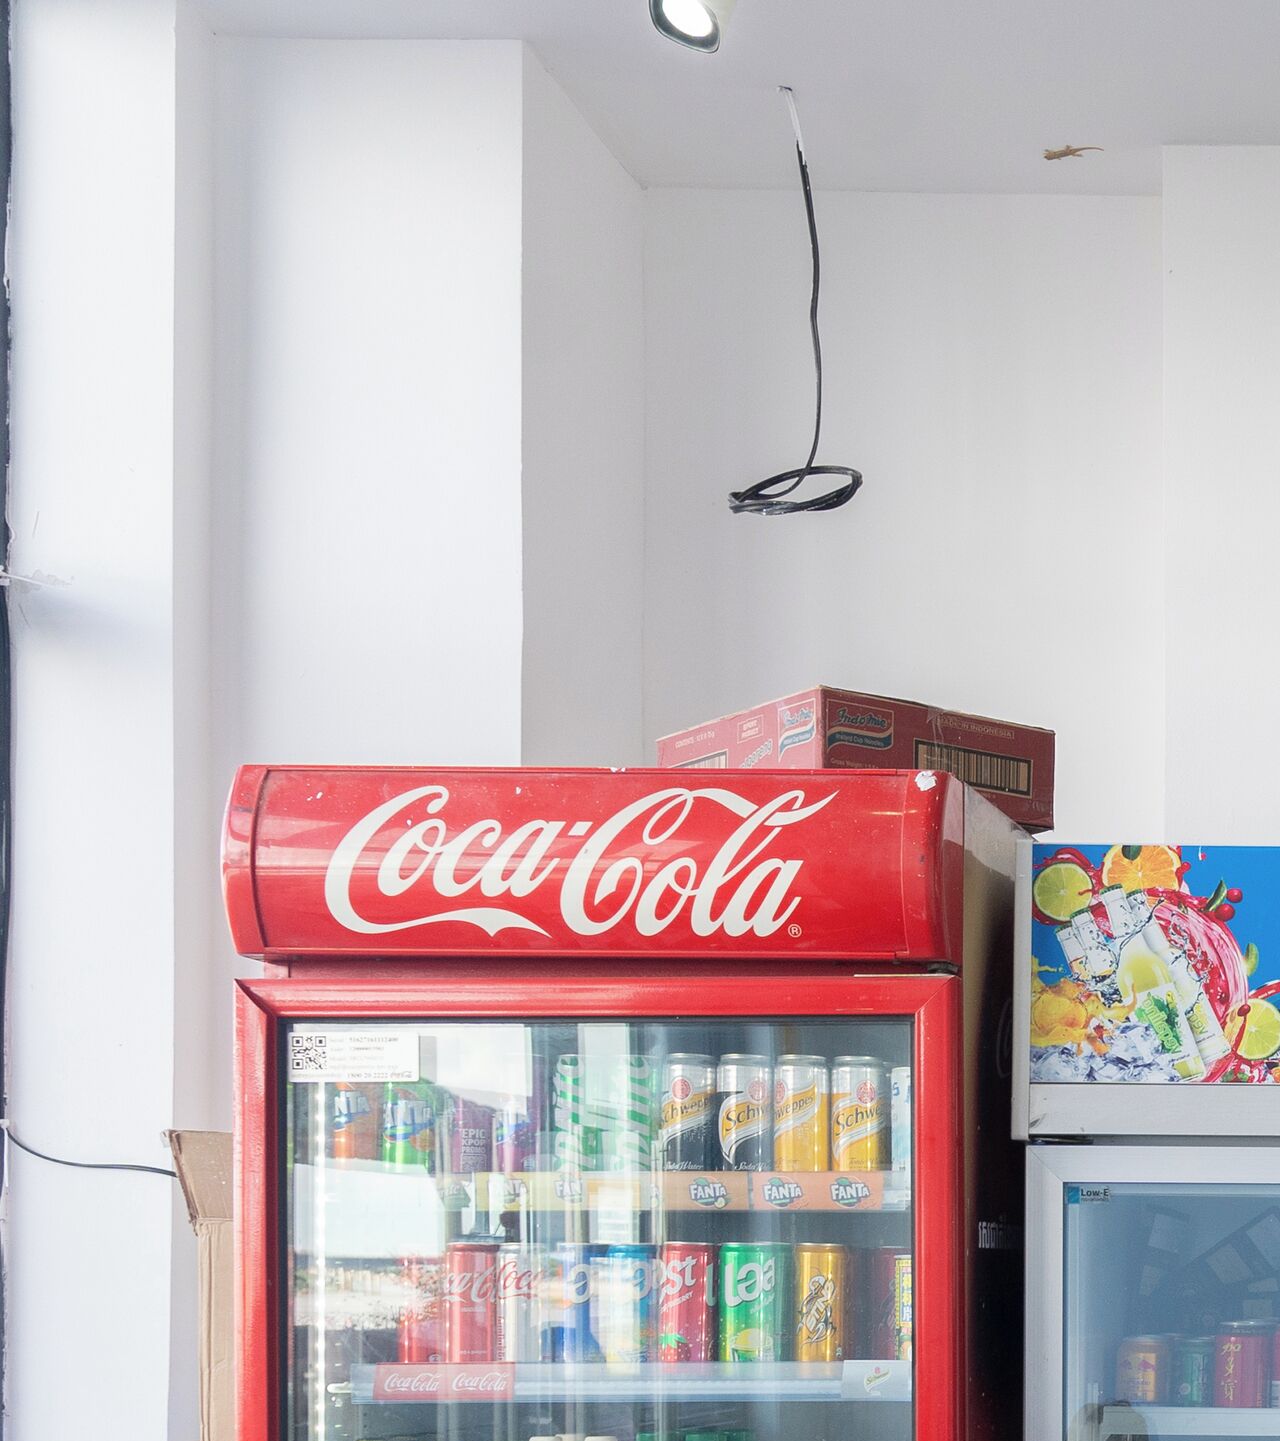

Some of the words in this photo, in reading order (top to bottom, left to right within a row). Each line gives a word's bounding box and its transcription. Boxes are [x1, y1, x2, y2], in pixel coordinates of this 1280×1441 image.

[324, 784, 841, 939] Coca-Cola
[460, 1127, 486, 1139] EPIC
[689, 1180, 727, 1198] FANTA
[763, 1180, 803, 1199] FANTA
[831, 1180, 870, 1199] FANTA
[1080, 1187, 1109, 1197] Low-E
[384, 1372, 441, 1393] Coca-Cola
[452, 1371, 511, 1393] Coca-Cola
